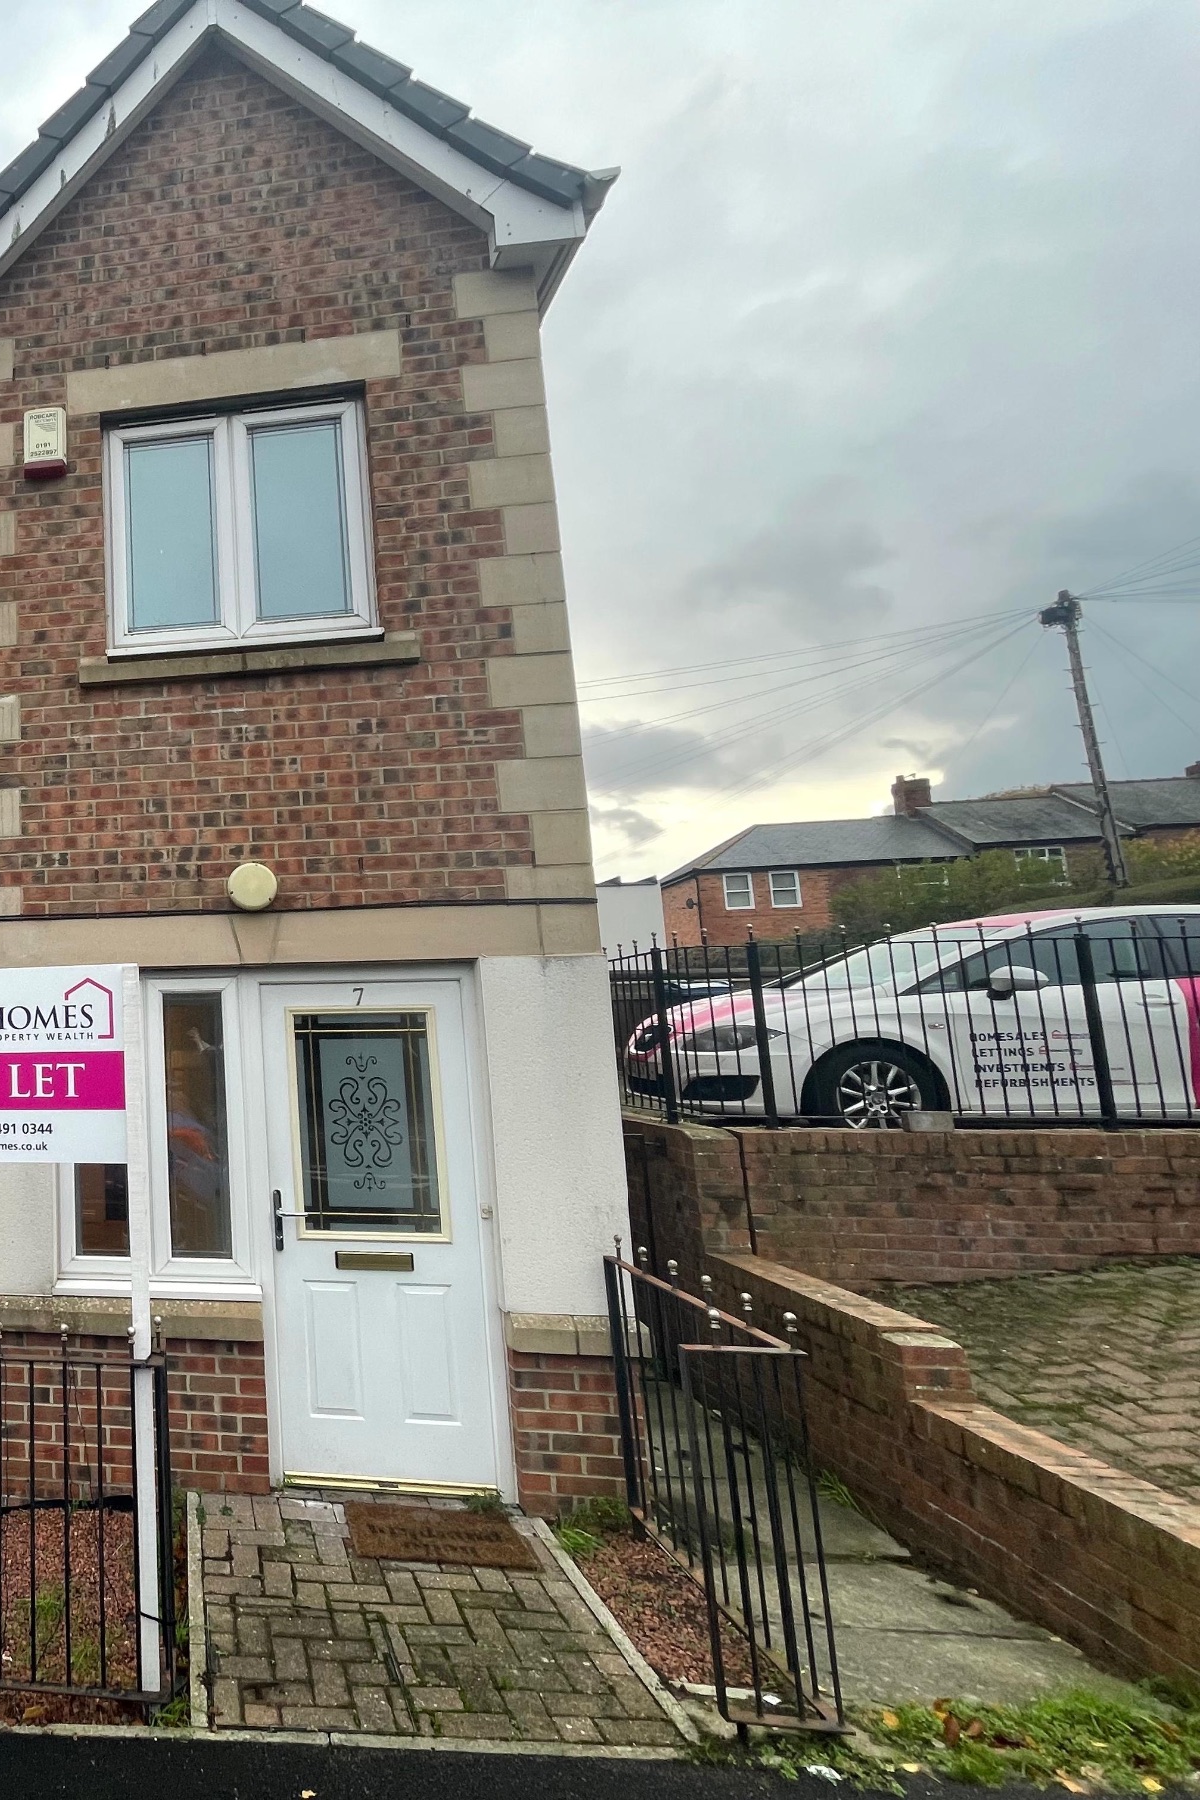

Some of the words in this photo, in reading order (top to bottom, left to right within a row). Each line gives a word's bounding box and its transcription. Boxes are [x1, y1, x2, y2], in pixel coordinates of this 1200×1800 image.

[352, 987, 364, 1006] 7
[46, 1032, 94, 1041] WEALTH
[8, 1062, 86, 1098] LET
[21, 1123, 53, 1134] 0344
